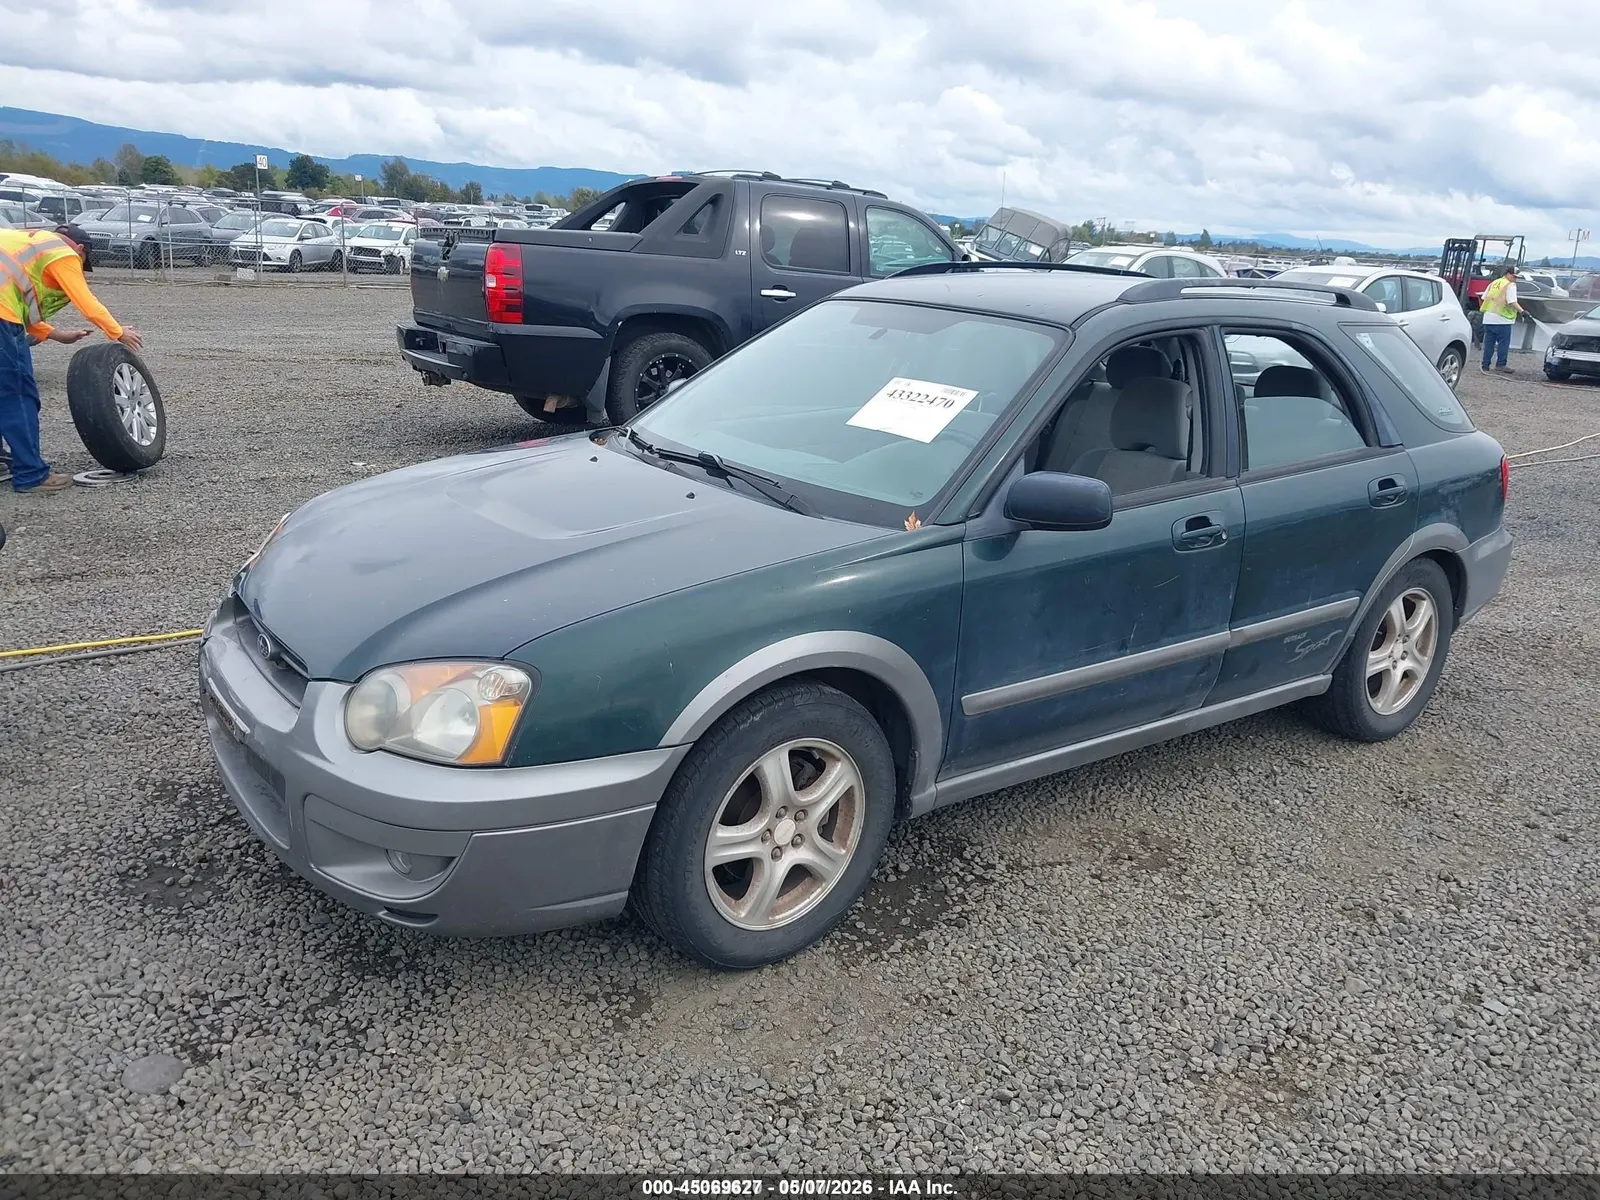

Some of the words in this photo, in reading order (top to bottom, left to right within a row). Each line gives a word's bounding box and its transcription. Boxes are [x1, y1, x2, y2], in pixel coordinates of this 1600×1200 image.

[257, 156, 267, 168] 40
[1581, 230, 1590, 241] M
[886, 388, 956, 409] 43322470
